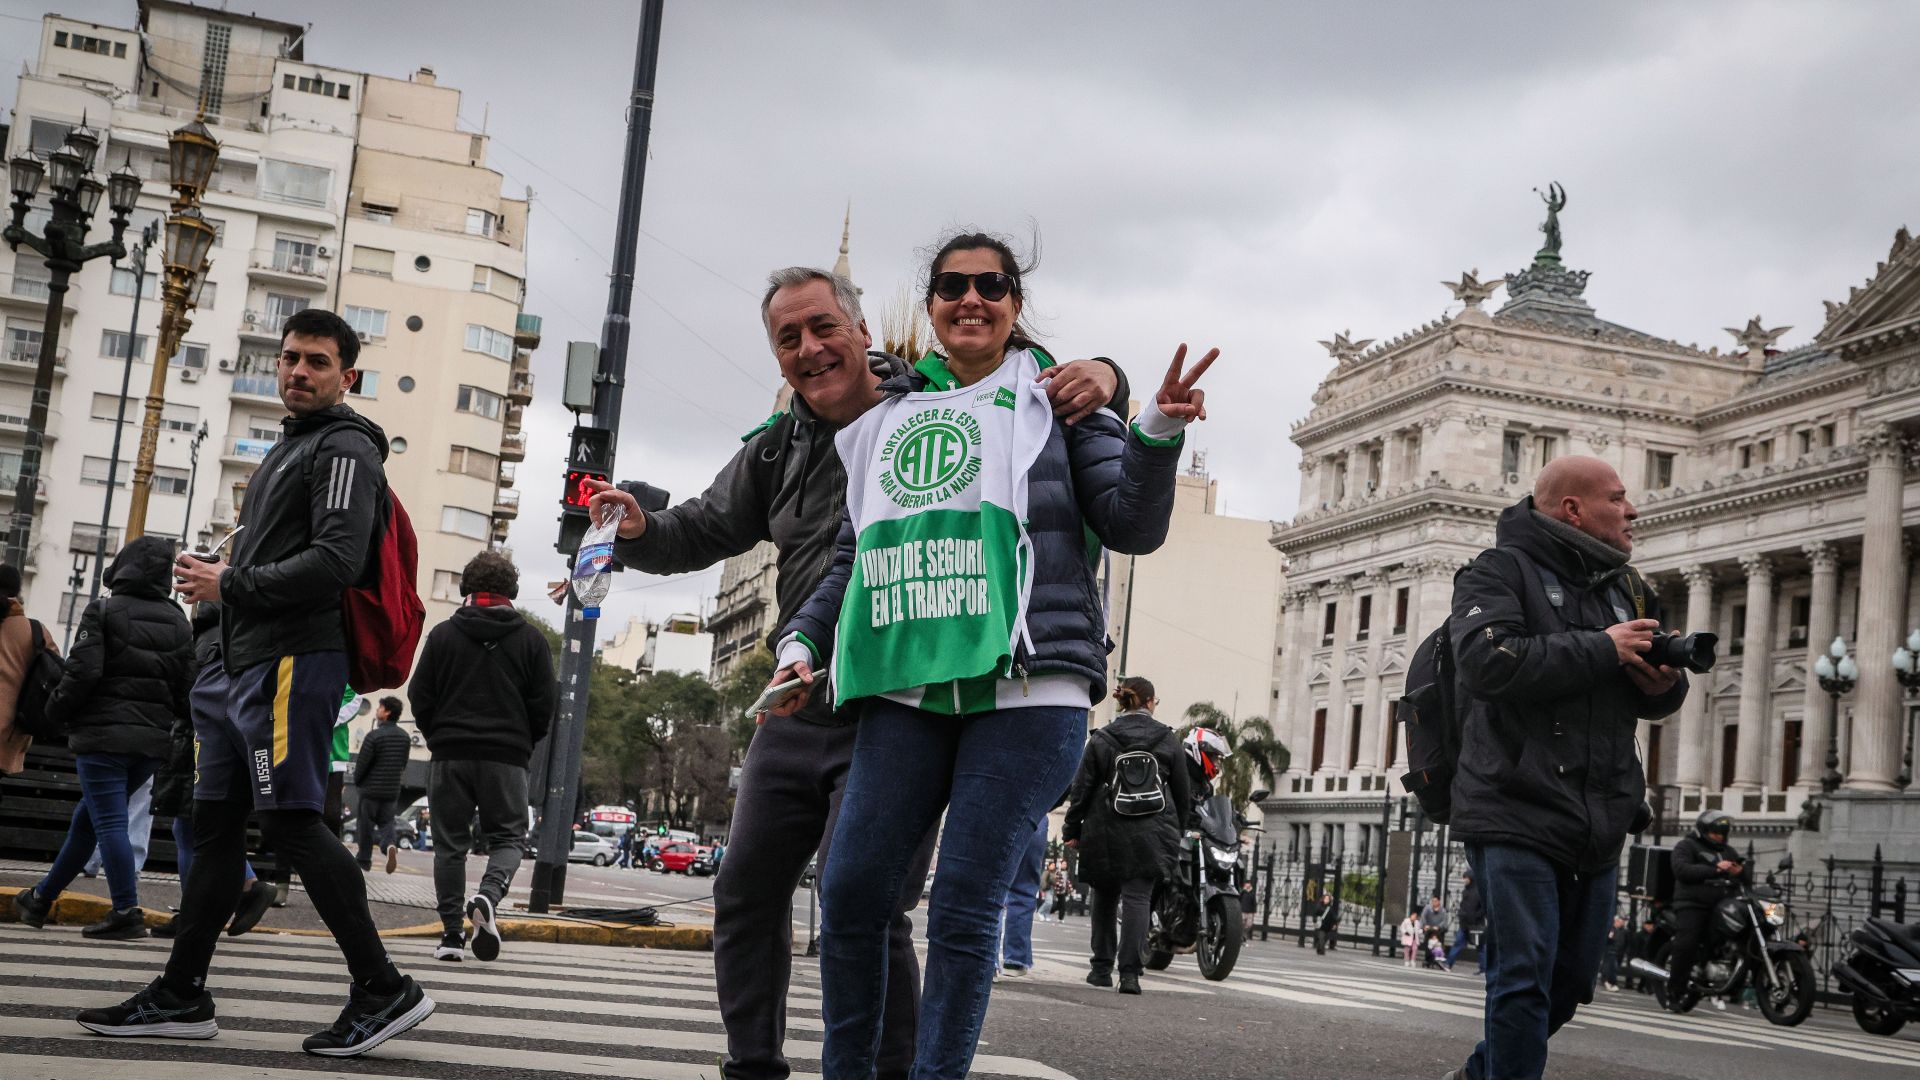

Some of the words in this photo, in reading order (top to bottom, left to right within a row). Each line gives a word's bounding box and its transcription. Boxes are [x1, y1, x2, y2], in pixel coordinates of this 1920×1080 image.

[880, 409, 939, 462] FORTALECER
[941, 408, 956, 421] EL
[901, 429, 959, 485] ATE
[878, 470, 898, 497] PARA
[891, 489, 933, 509] LIBERAR
[935, 486, 952, 502] LA
[949, 455, 982, 495] NACION
[860, 546, 902, 588] JUNTA
[903, 540, 924, 580] DE
[925, 537, 987, 578] SEGURI
[871, 587, 890, 628] EN
[891, 583, 905, 624] EL
[905, 577, 991, 620] TRANSPOR
